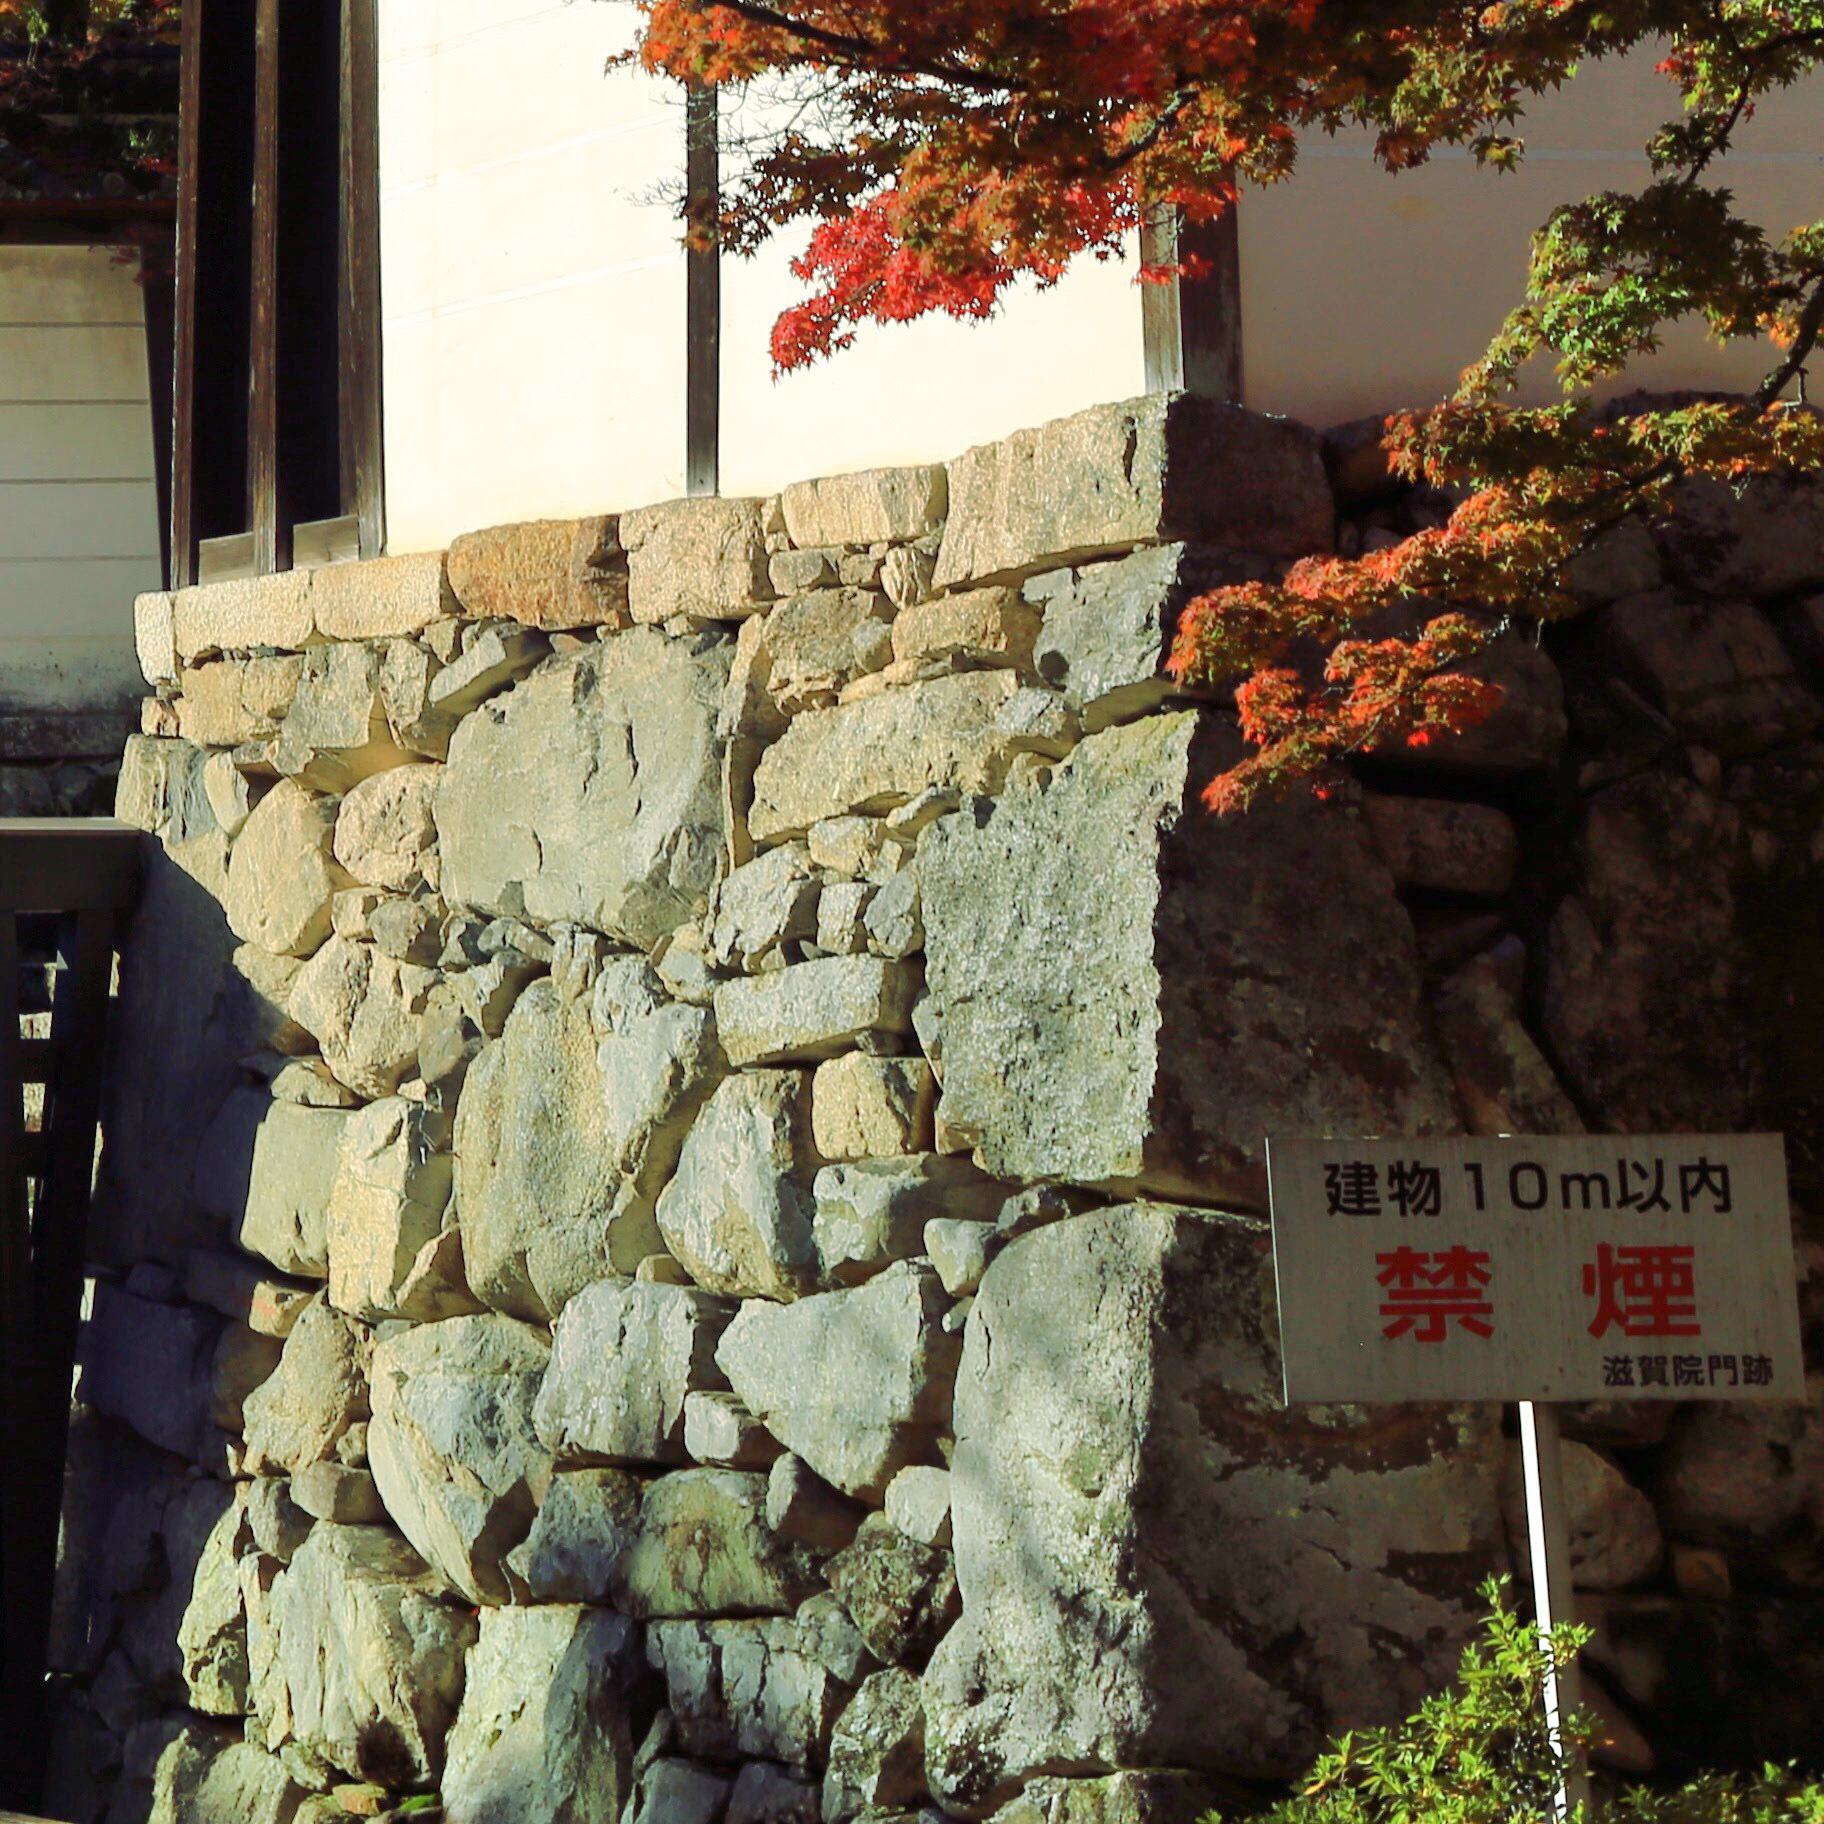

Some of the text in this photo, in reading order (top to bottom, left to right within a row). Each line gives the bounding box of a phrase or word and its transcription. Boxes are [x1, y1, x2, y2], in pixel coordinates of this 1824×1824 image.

[1324, 1157, 1732, 1216] 建物10m以内
[1375, 1242, 1701, 1342] 禁煙
[1602, 1354, 1774, 1388] 滋賀院門跡
